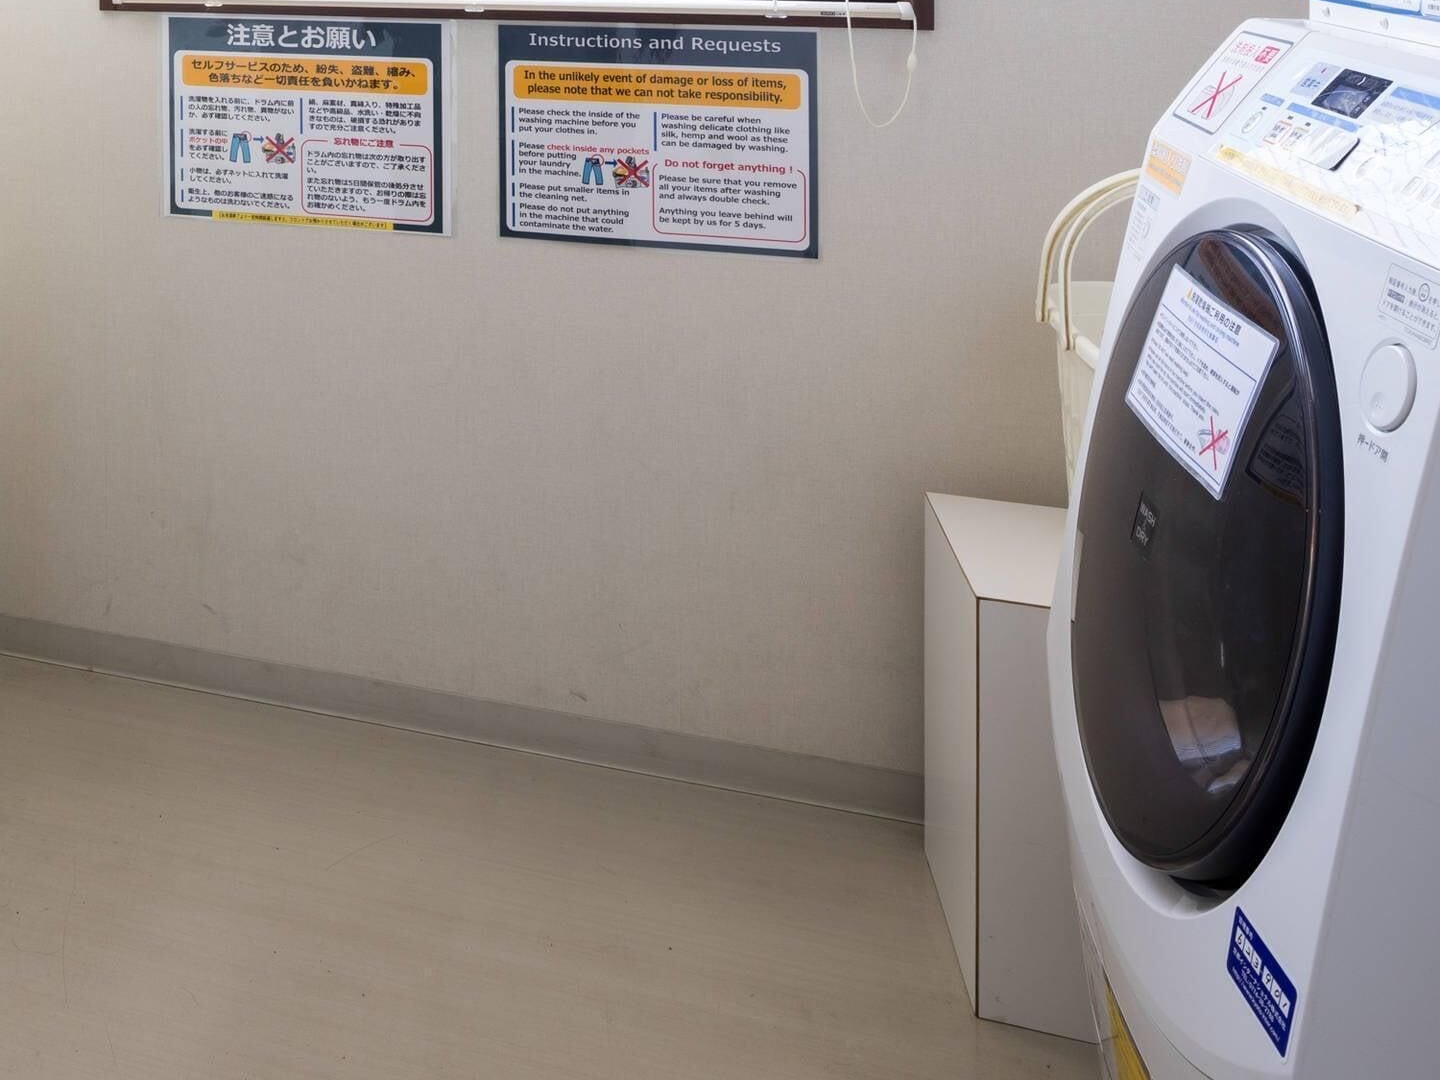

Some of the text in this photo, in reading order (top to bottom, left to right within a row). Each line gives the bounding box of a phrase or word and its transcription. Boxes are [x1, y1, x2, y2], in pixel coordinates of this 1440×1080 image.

[226, 23, 376, 50] 注意とお願い
[529, 32, 780, 55] Instructions and Requests
[208, 72, 398, 90] 色落ちなど一切責任を負いかねます。
[524, 70, 786, 89] In the unlikely event of damage or loss of items,
[527, 82, 782, 104] please note that we can not take responsibility.
[188, 136, 228, 144] ポケットの中
[333, 137, 393, 148] 忘れ物にご注意
[188, 152, 225, 160] てください。
[664, 159, 678, 167] Do
[682, 160, 699, 168] not
[702, 160, 734, 172] forget
[737, 162, 785, 174] anything
[189, 175, 231, 184] してください。
[658, 174, 686, 182] Please
[723, 177, 741, 185] that
[744, 180, 760, 188] you
[763, 181, 797, 189] remove
[671, 185, 690, 193] your
[693, 185, 717, 193] items
[719, 186, 741, 194] after
[743, 188, 780, 198] washing
[677, 193, 707, 202] always
[708, 194, 739, 203] double
[741, 196, 769, 205] check.
[658, 206, 697, 217] Anything
[700, 210, 716, 218] you
[718, 210, 741, 218] leave
[744, 212, 774, 220] behind
[659, 215, 669, 223] be
[672, 216, 691, 225] kept
[693, 218, 704, 226] by
[742, 220, 765, 230] days.
